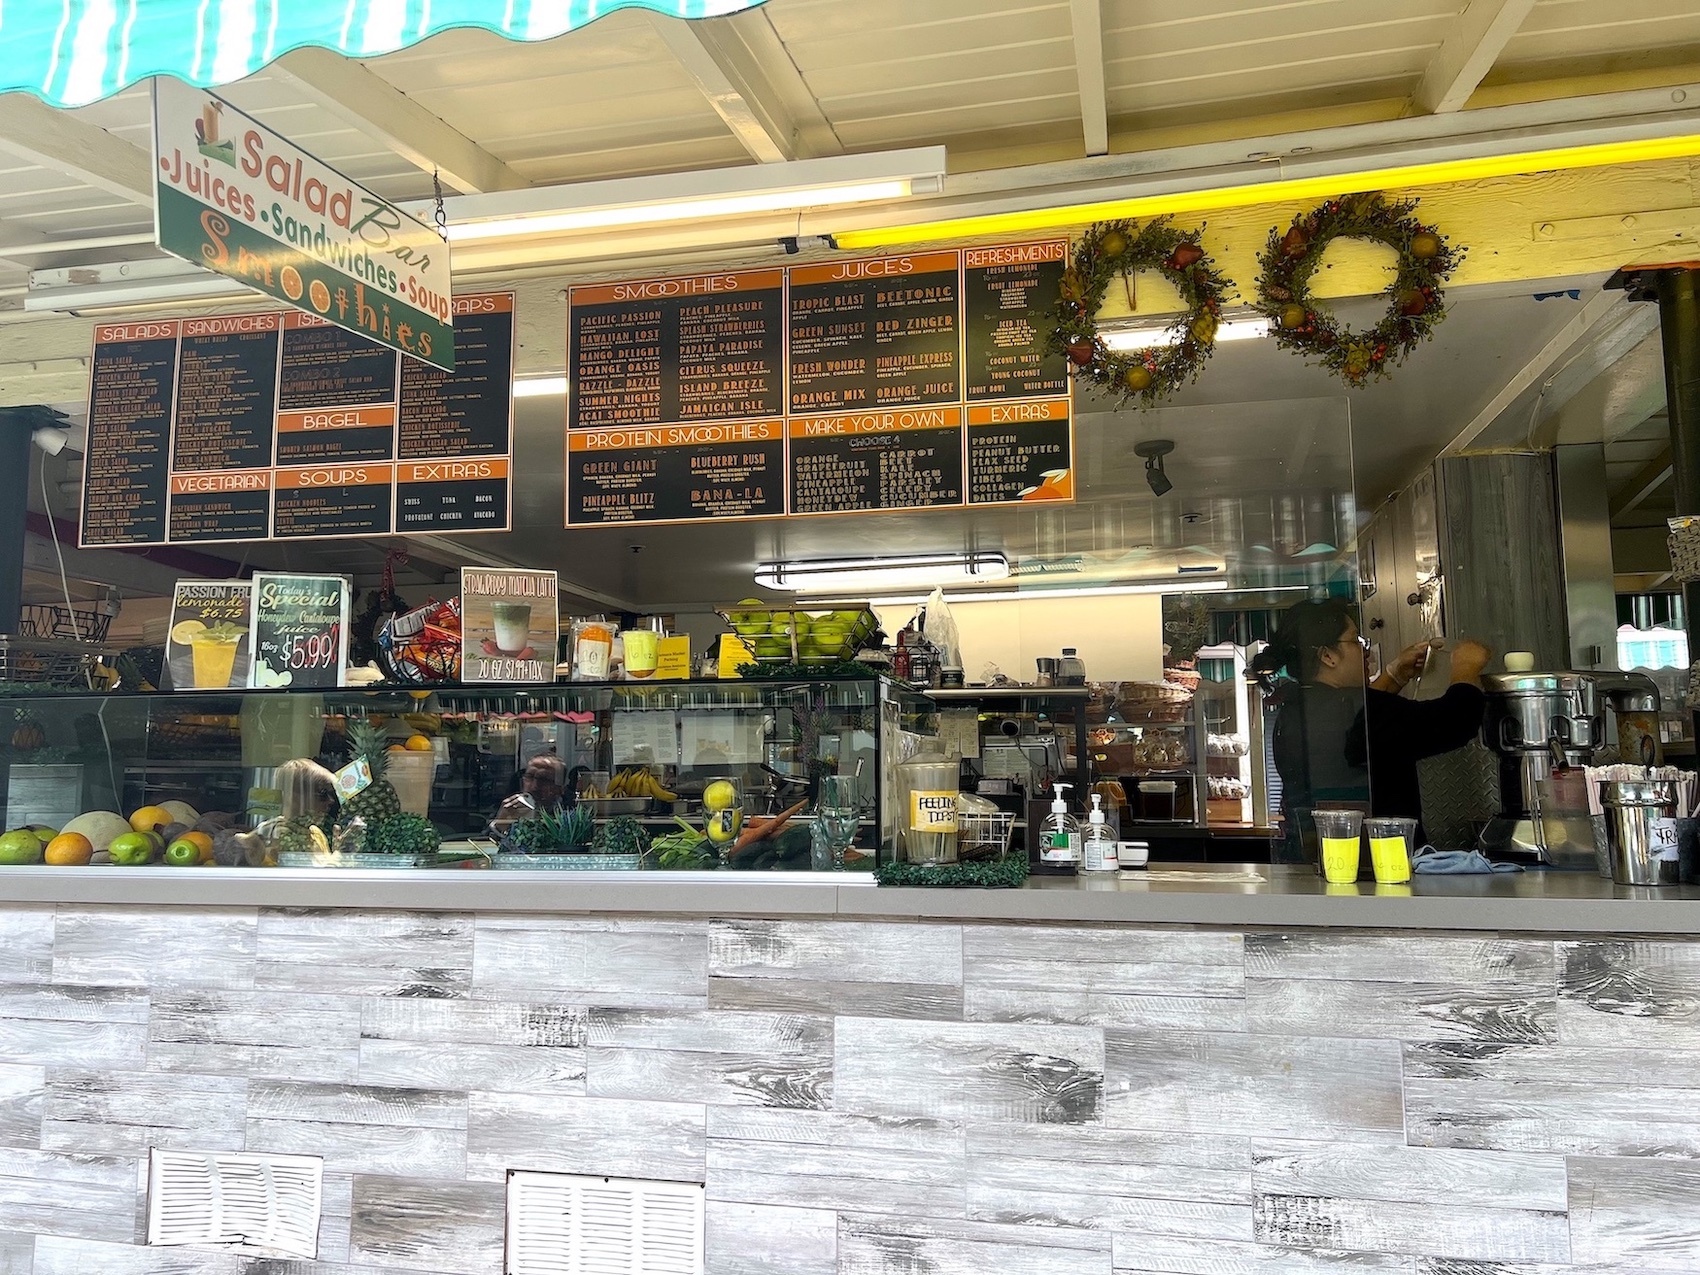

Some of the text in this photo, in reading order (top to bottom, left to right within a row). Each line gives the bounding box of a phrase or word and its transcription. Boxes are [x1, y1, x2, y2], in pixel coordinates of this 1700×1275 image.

[241, 130, 432, 274] Salad Bar
[966, 246, 1064, 266] REFRESHMENTS
[832, 258, 913, 279] JUICES
[987, 264, 1038, 275] FRESH LEMONADE
[201, 209, 433, 357] Smoothies
[613, 276, 738, 300] SMOOTHIES
[988, 279, 1038, 291] FRUIT LEMONADE
[409, 276, 449, 326] Soup
[876, 286, 952, 302] BEETONIC
[452, 299, 495, 313] RAPS
[680, 301, 764, 316] PEACH PLEASURE
[793, 294, 865, 310] TROPIC BLAST
[188, 317, 275, 334] SANDWICHES
[580, 311, 662, 326] PACIFIC PASSION
[876, 315, 953, 331] RED ZINGER
[102, 324, 171, 341] SALADS
[679, 321, 765, 335] SPLASH STRAWBERRIES
[792, 322, 866, 338] GREEN SUNSET
[580, 329, 660, 344] HAWAIIAN LOST
[580, 347, 661, 361] MANGO DELIGHT
[680, 340, 763, 355] PAPAYA PARADISE
[792, 359, 866, 374] FRESH WONDER
[876, 352, 953, 368] PINEAPPLE EXPRESS
[990, 354, 1040, 365] COCONUT WATER
[579, 362, 660, 375] ORANGE OASIS
[679, 360, 765, 376] CITRUS SQUEEZE
[991, 369, 1041, 380] YOUNG COCONUT
[579, 380, 613, 391] RAZZLE
[626, 377, 660, 387] DAZZLE
[679, 379, 764, 393] ISLAND BREEZE
[876, 382, 954, 398] ORANGE JUICE
[968, 380, 1065, 394] FRUIT BOWL WATER BOTTLE
[579, 393, 661, 406] SUMMER NIGHTS
[792, 389, 866, 404] ORANGE MIX
[579, 407, 660, 421] ACAI SMOOTHIE
[680, 400, 764, 415] JAMAICAN ISLE
[991, 404, 1050, 422] EXTRAS
[303, 413, 367, 429] BAGEL
[806, 411, 944, 435] MAKE YOUR OWN
[586, 424, 770, 448] PROTEIN SMOOTHIES
[849, 436, 892, 447] CHOOSE
[972, 435, 1017, 445] PROTEIN
[879, 448, 935, 459] CARROT
[972, 445, 1060, 457] PEANUT BUTTER
[690, 453, 766, 468] BLUEBERRY RUSH
[796, 454, 839, 464] ORANGE
[880, 457, 913, 466] BEET
[972, 456, 1029, 466] FLAX SEED
[414, 463, 491, 480] EXTRAS
[583, 459, 658, 474] GREEN GIANT
[796, 460, 866, 473] GRAPEFRUIT
[880, 464, 915, 473] KALE
[973, 464, 1028, 475] TURMERIC
[299, 469, 367, 486] SOUPS
[796, 469, 870, 481] WATERMELON
[880, 469, 941, 480] SPINACH
[973, 475, 1003, 483] FIBER
[178, 475, 266, 491] VEGETARIAN
[796, 478, 856, 488] PINEAPPLE
[880, 477, 942, 487] PARSLEY
[973, 482, 1025, 493] COLLAGEN
[796, 485, 866, 497] CANTALOUPE
[880, 485, 932, 494] CELERY
[880, 490, 957, 501] CUCUMBER
[583, 492, 655, 507] PINEAPPLE BLITZ
[796, 494, 858, 505] HONEYDEW
[880, 499, 933, 508] GINGER
[973, 493, 1005, 502] DATES
[797, 501, 872, 512] GREEN APPLE
[178, 586, 251, 599] PASSION FRU
[277, 585, 312, 596] Today's
[464, 574, 556, 598] STRAWBERRY MATCHA LATTE
[177, 594, 245, 607] lemonade
[260, 583, 339, 610] Special
[200, 608, 243, 619] $6.75
[257, 611, 340, 627] Honeydew Cantaloupe
[273, 625, 321, 635] juice
[280, 634, 332, 669] $5.99
[479, 659, 489, 680] 20
[491, 659, 501, 680] OZ
